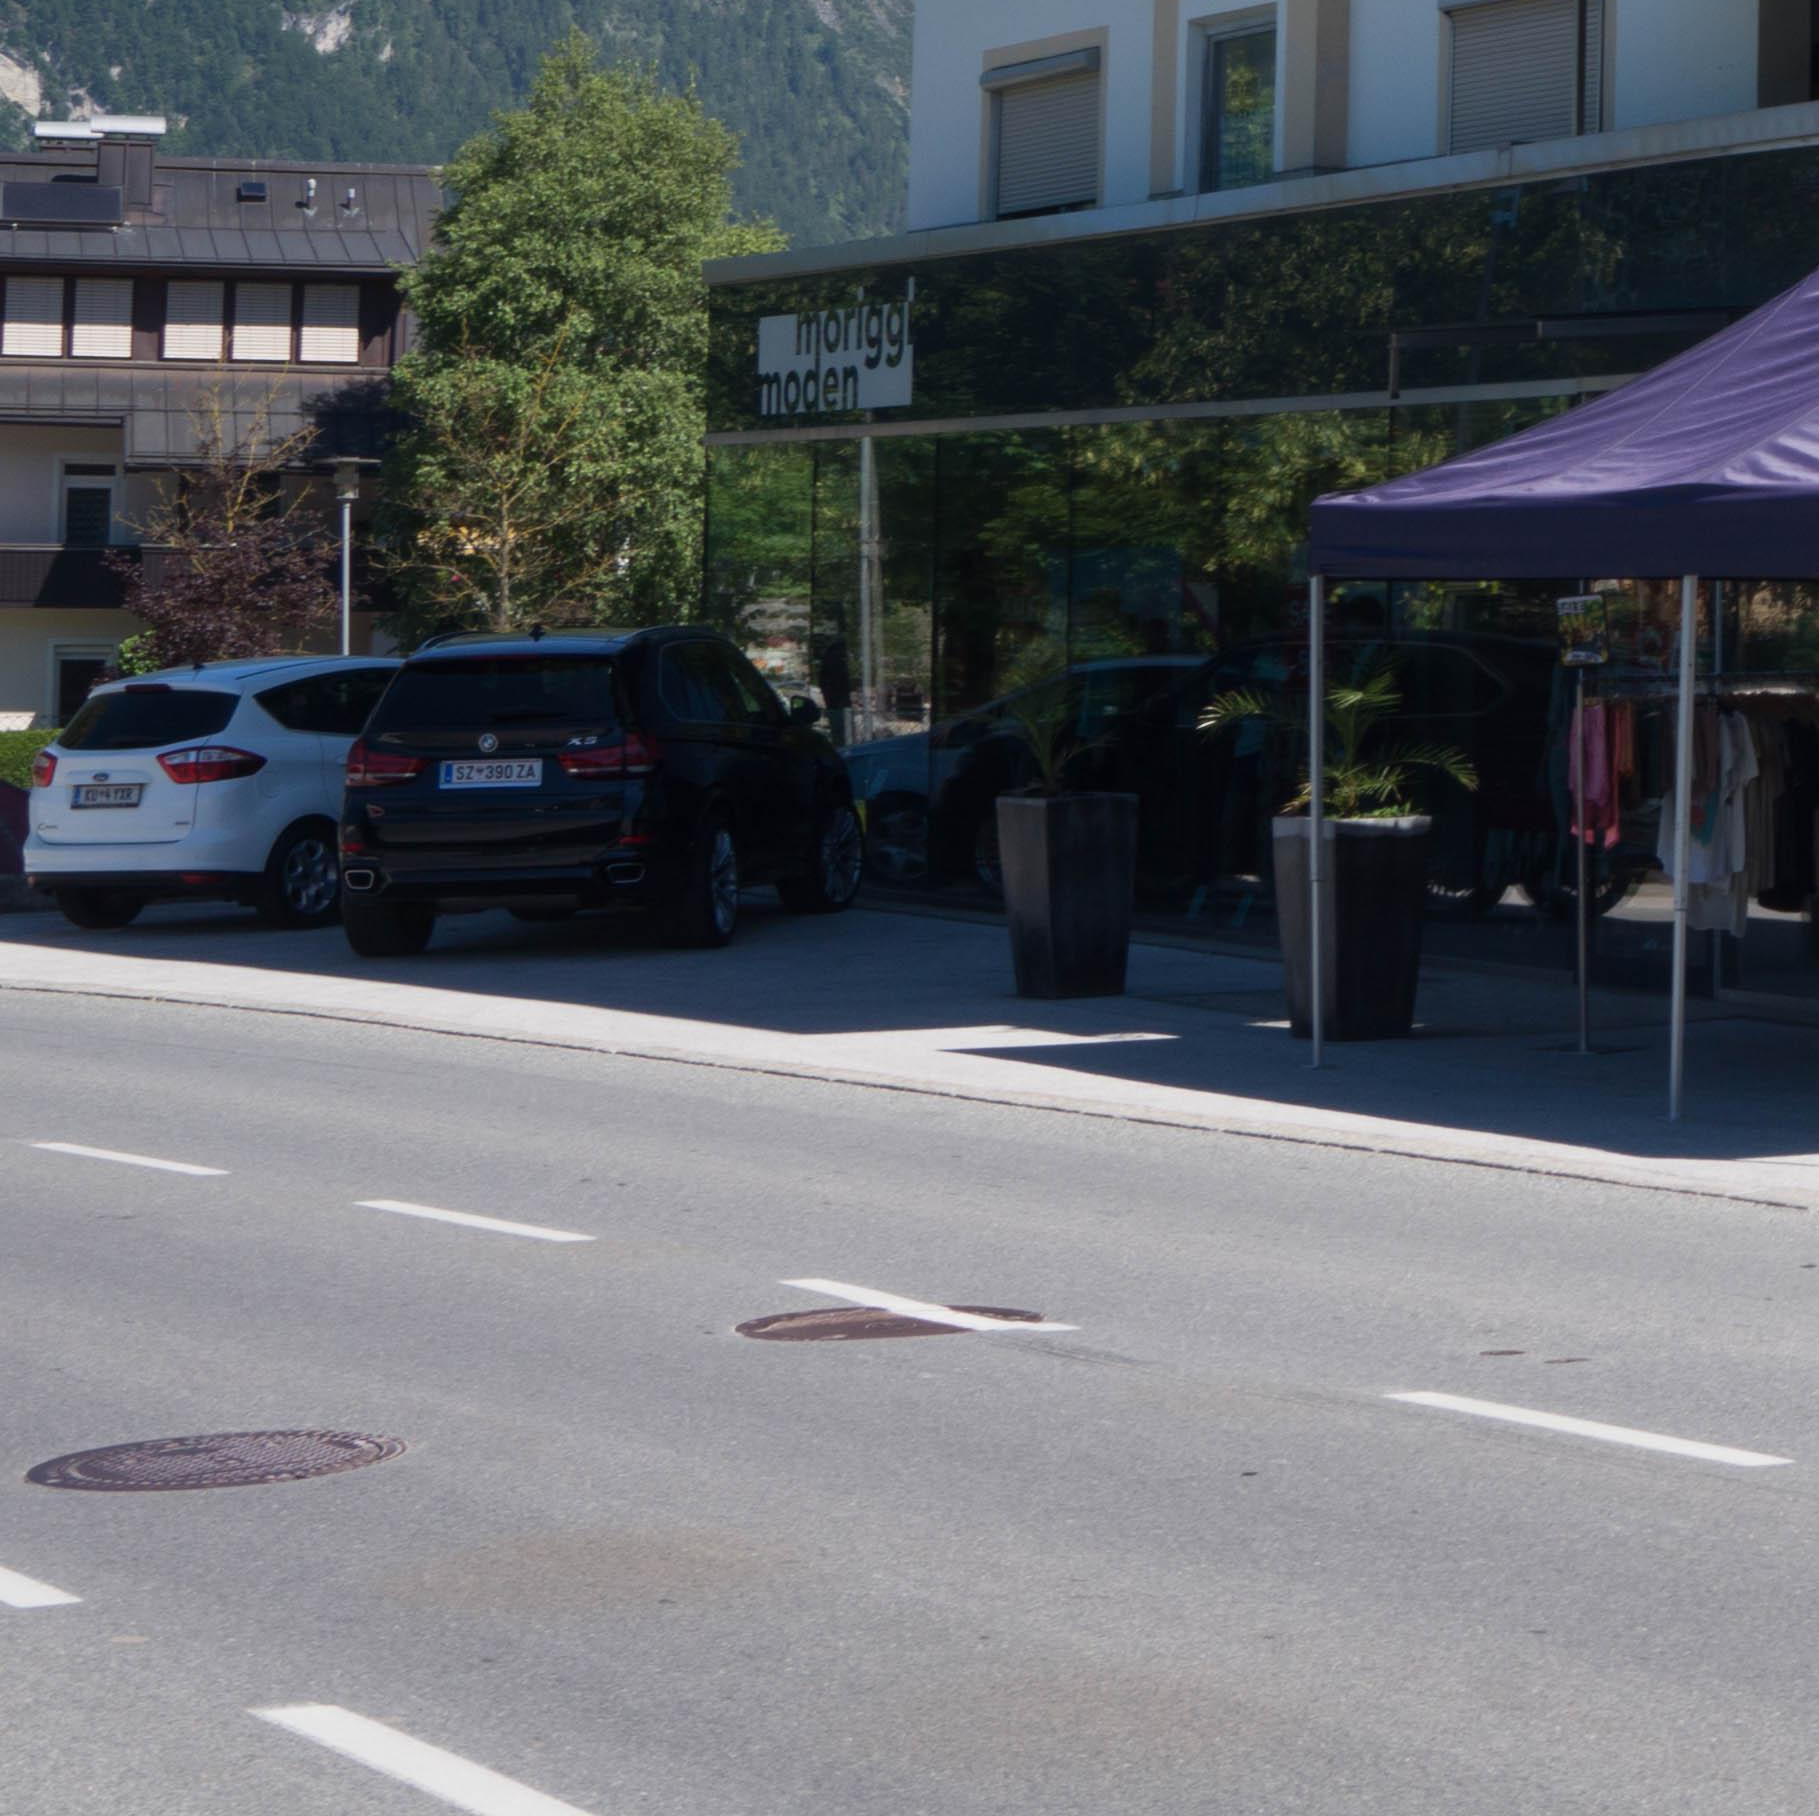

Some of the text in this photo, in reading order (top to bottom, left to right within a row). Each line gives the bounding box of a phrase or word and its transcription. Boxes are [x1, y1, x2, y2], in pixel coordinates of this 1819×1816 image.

[757, 354, 859, 416] moden
[456, 764, 536, 781] SZ 390 ZA
